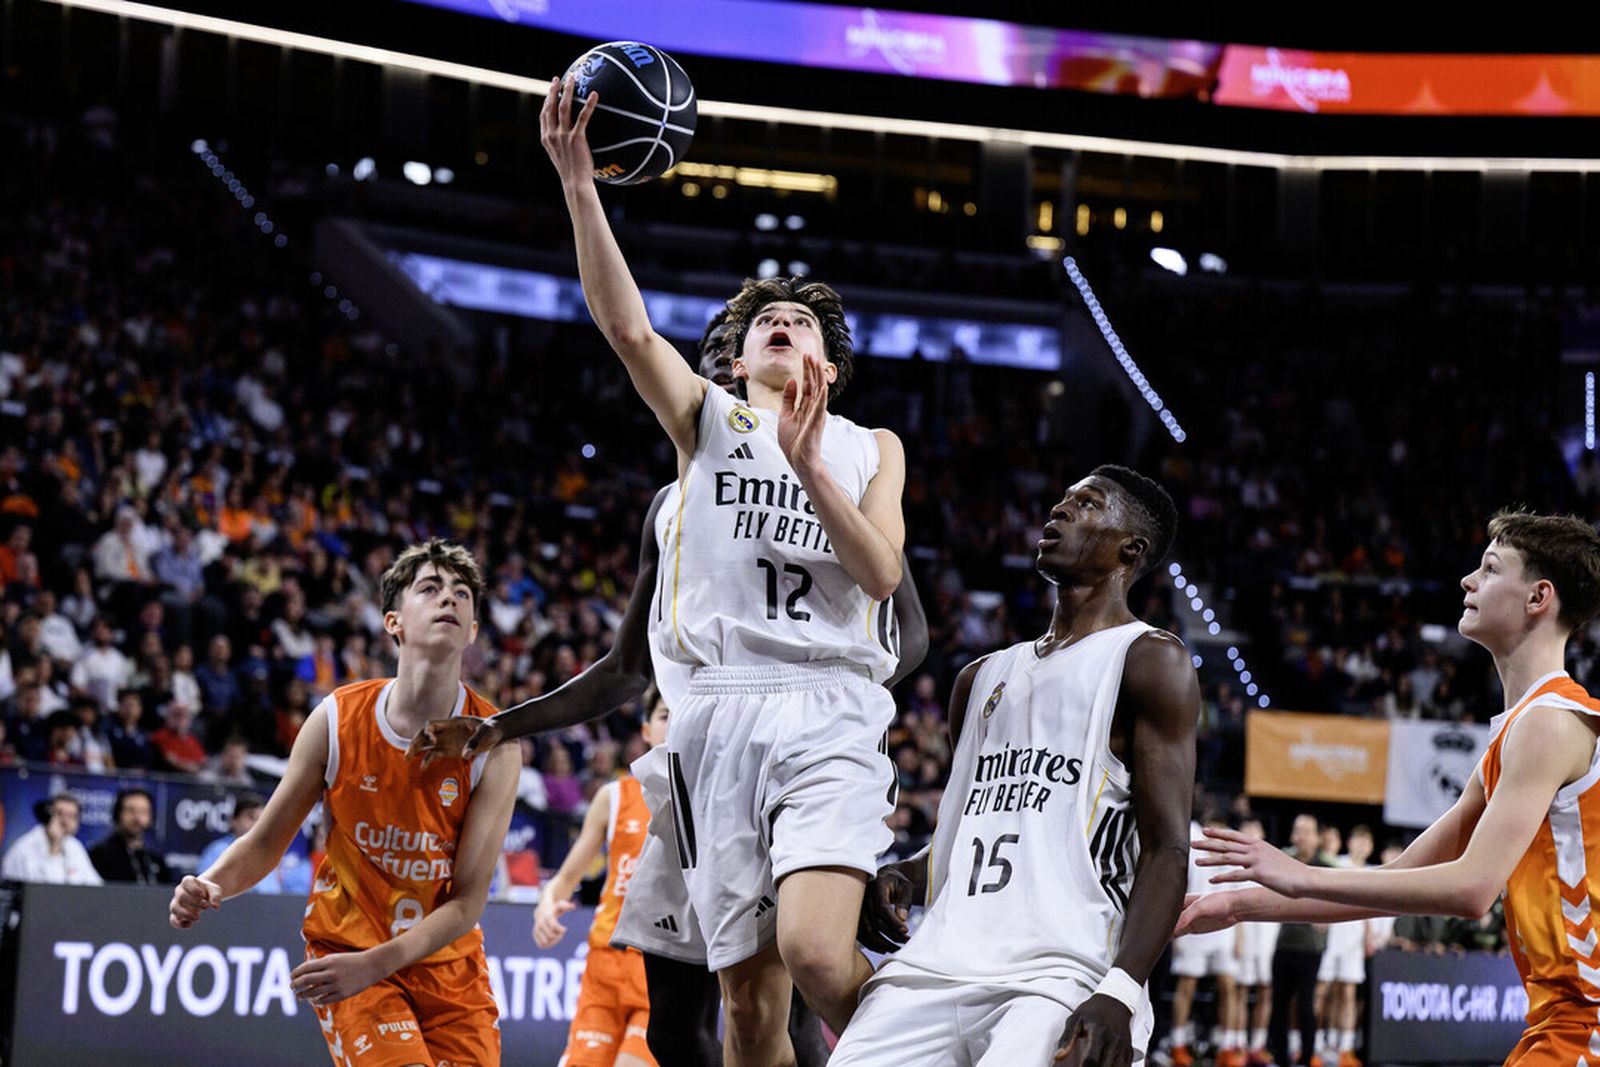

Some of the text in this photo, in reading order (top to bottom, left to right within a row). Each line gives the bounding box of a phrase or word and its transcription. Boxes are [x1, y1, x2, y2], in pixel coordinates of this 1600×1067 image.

[733, 510, 770, 539] FLY
[756, 558, 813, 622] 12
[967, 833, 1020, 897] 15
[390, 898, 424, 939] 8
[53, 941, 298, 1017] TOYOTA
[1380, 981, 1450, 1022] TOYOTA
